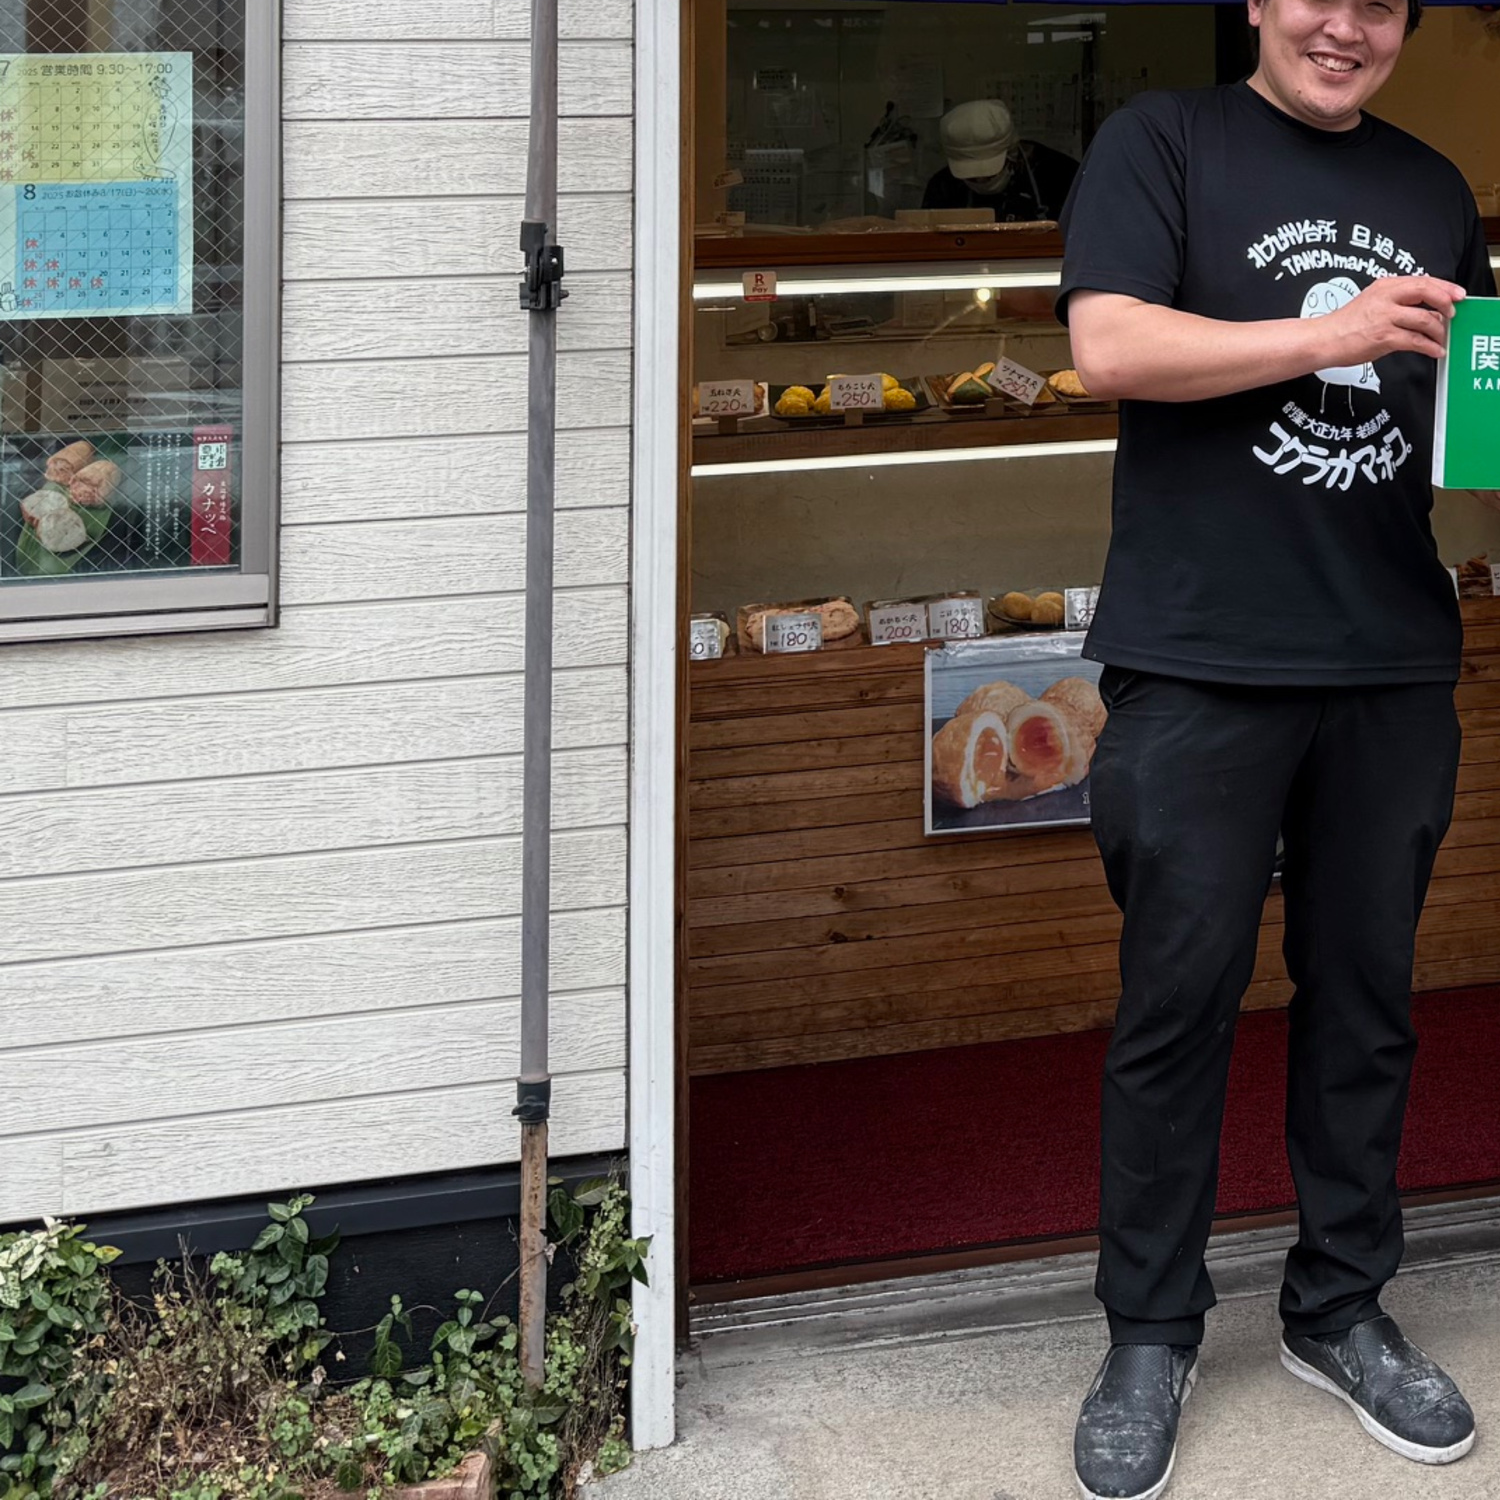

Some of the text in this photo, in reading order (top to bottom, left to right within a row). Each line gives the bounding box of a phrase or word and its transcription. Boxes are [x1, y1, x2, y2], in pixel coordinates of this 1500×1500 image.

[23, 184, 36, 200] 8
[1247, 219, 1338, 269] 北九州台所
